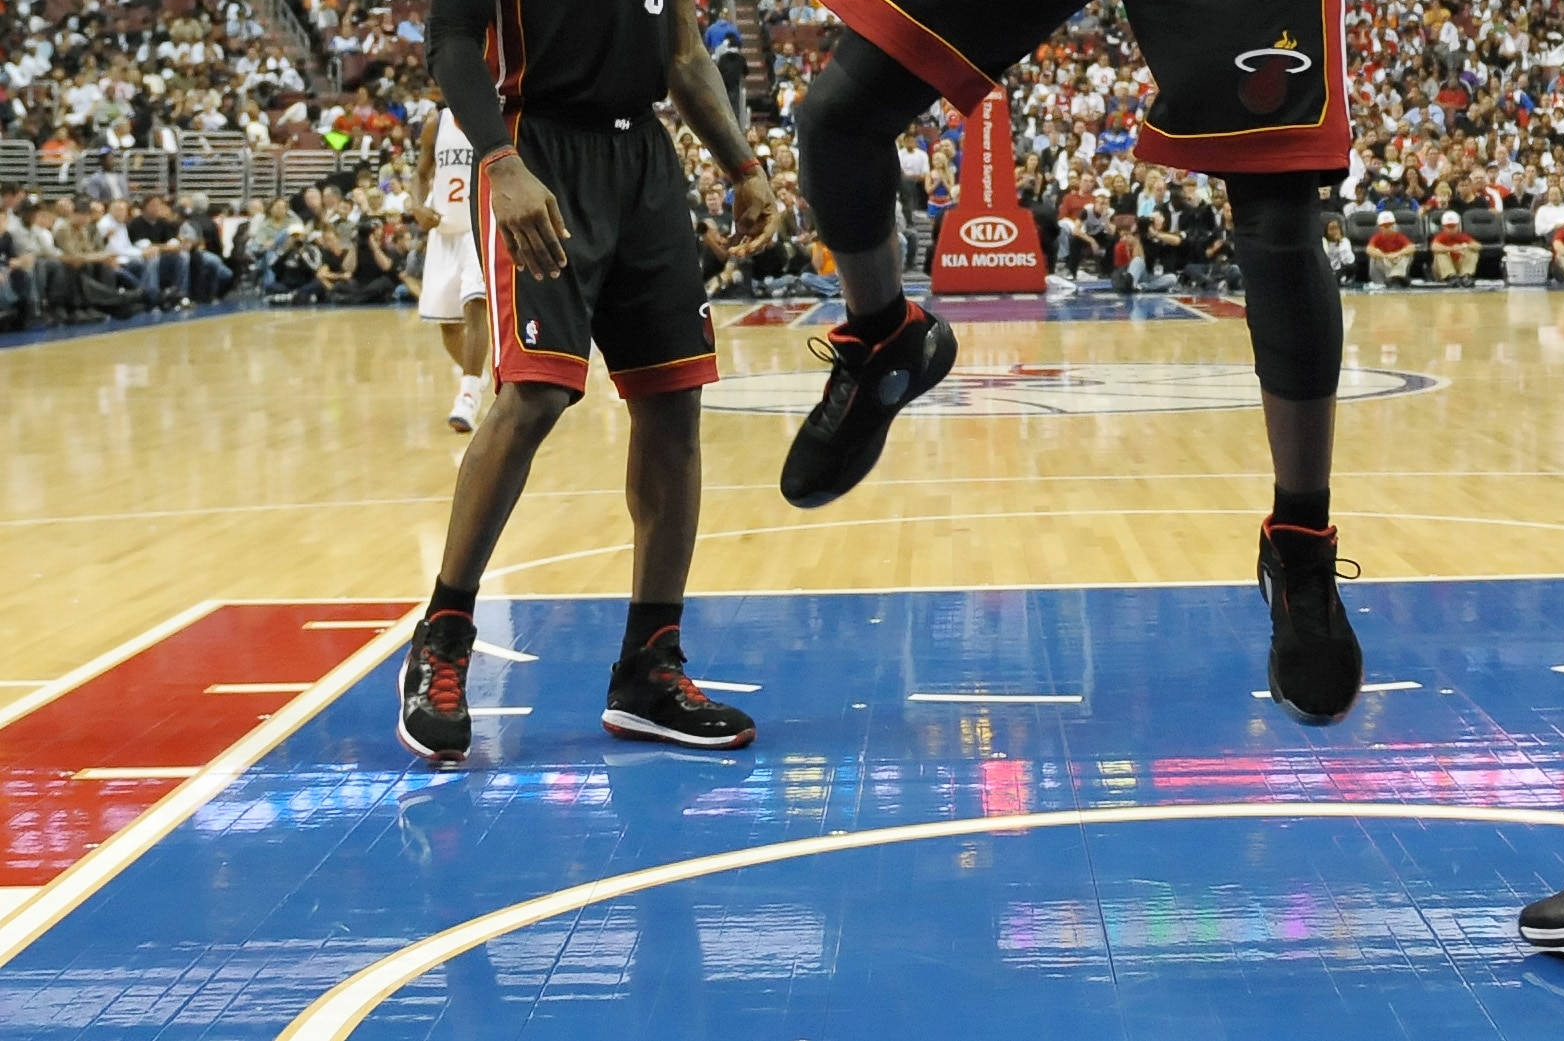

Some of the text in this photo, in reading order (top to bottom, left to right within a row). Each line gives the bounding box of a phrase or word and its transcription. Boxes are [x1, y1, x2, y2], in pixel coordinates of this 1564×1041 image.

[437, 148, 473, 168] SIXE
[447, 176, 470, 203] 2
[969, 223, 1009, 241] KIA
[941, 252, 1037, 268] KIA MOTORS
